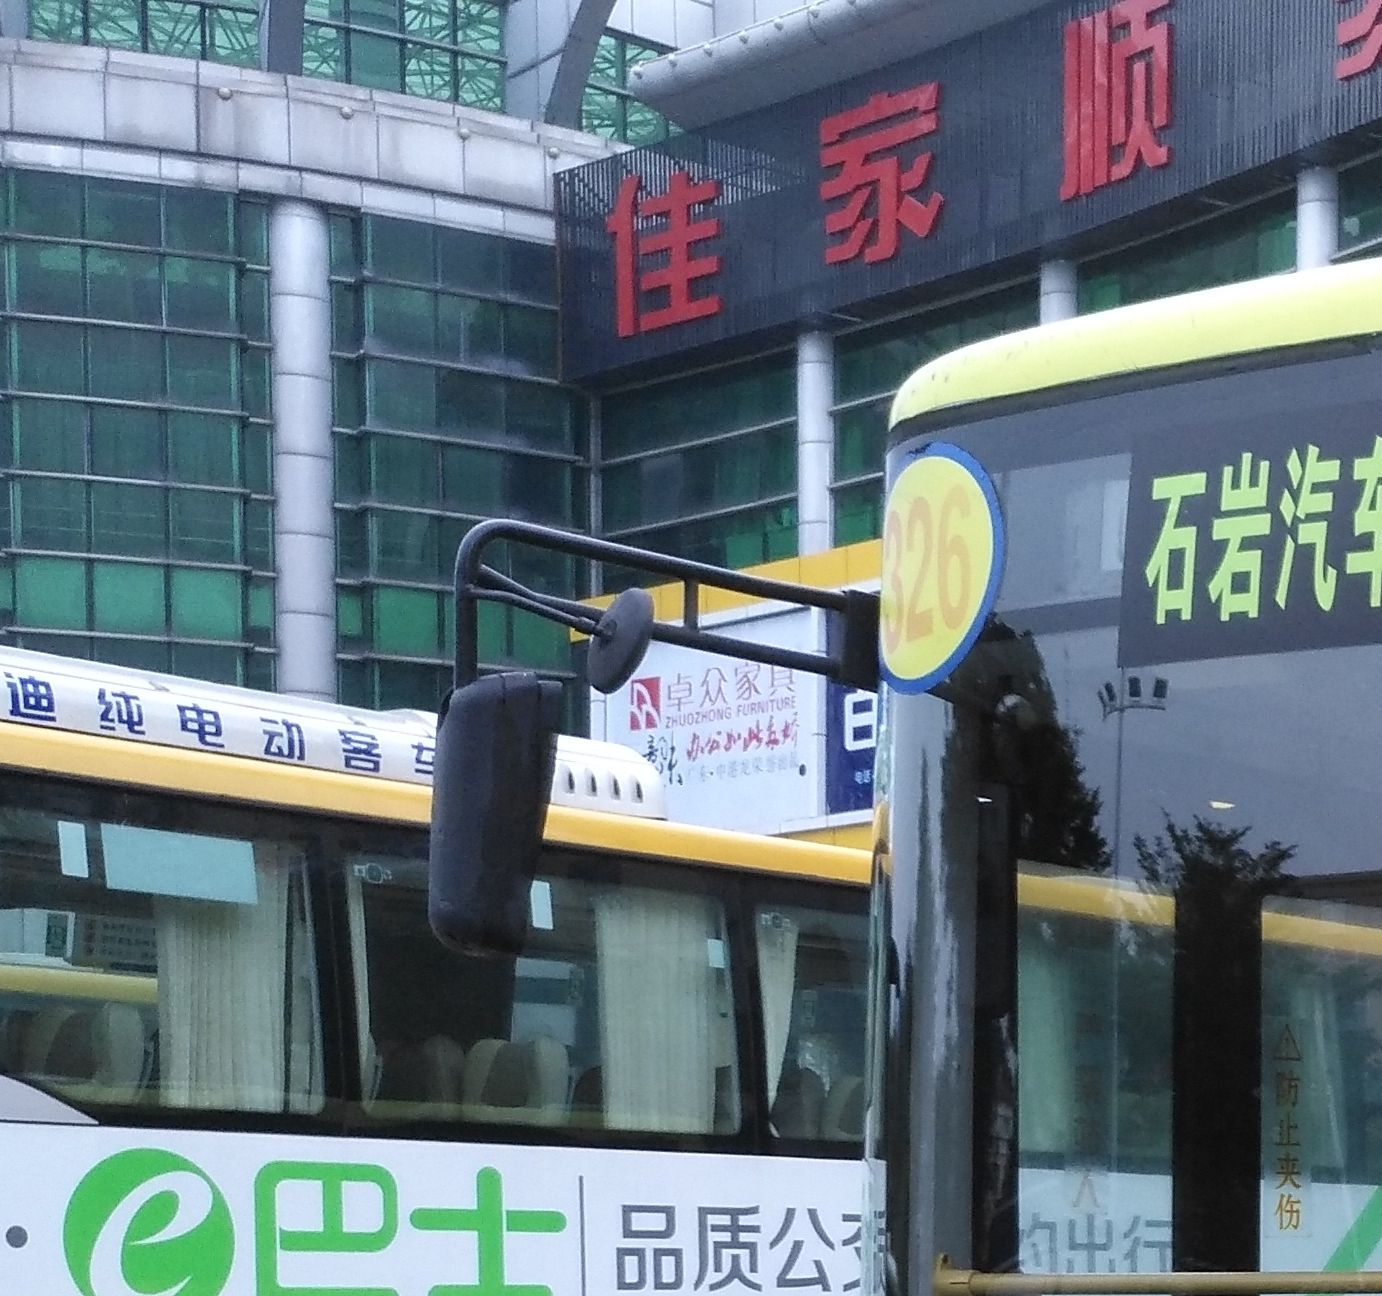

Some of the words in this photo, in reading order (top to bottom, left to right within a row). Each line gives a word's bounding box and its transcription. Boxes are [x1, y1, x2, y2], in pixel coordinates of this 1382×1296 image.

[665, 706, 732, 729] ZHUOZHONG
[736, 695, 797, 717] FURNITURE
[1274, 1070, 1302, 1231] 防止夹伤
